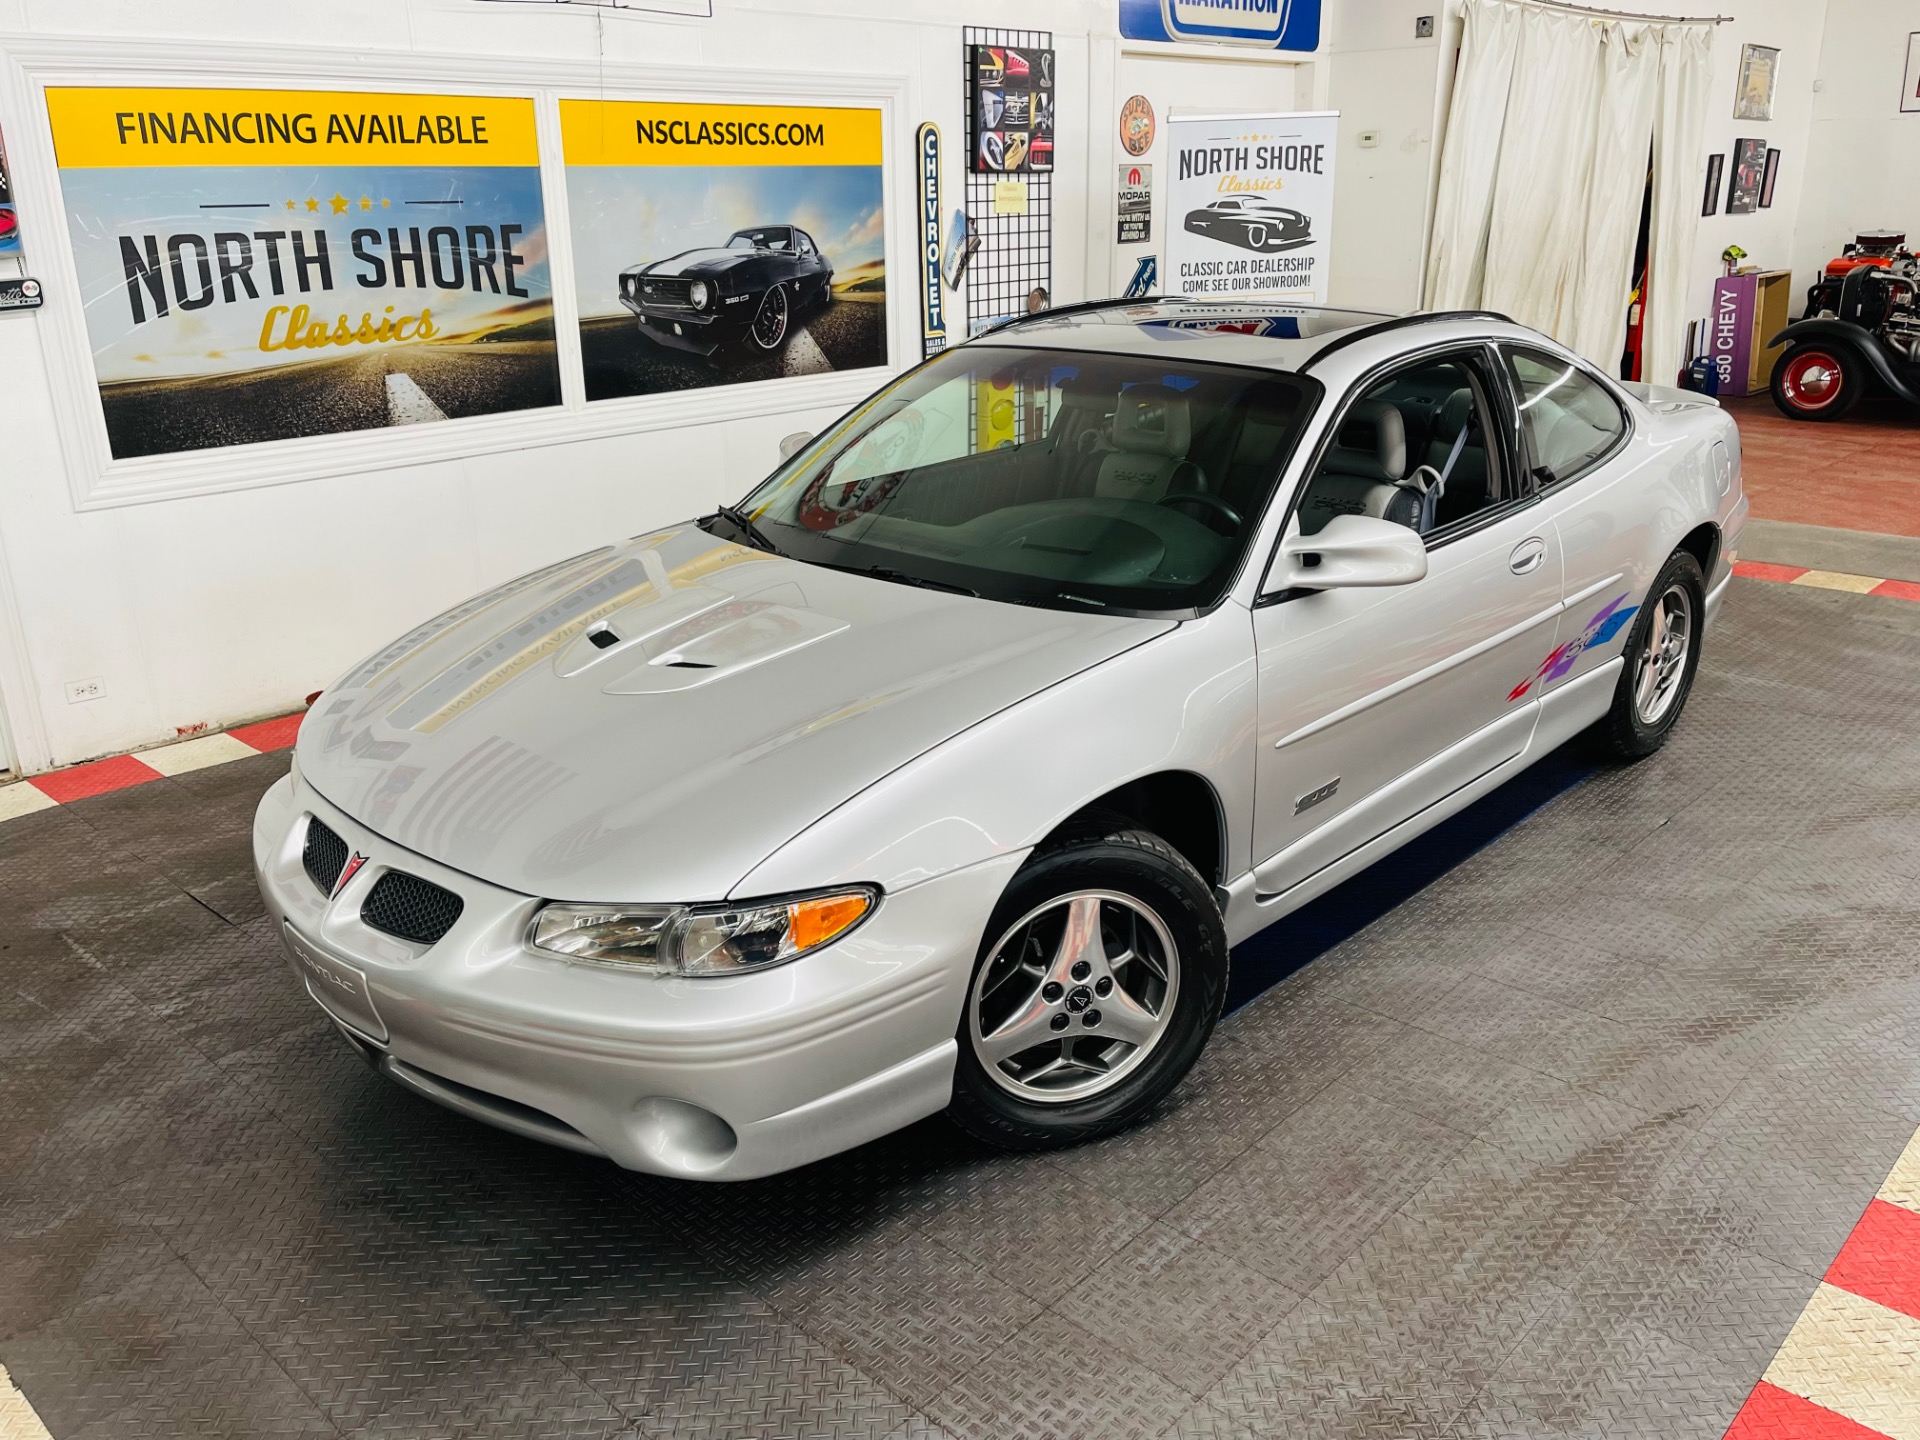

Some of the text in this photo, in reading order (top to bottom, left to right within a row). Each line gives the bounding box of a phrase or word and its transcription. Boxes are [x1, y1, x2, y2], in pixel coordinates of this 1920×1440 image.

[115, 111, 489, 145] FINANCING AVAILABLE
[1123, 99, 1151, 129] SUPER
[636, 119, 824, 147] NSCLASSICS.COM
[1128, 131, 1150, 152] BEE
[1179, 144, 1325, 181] NORTH SHORE
[1118, 191, 1150, 201] MOPAR
[1217, 175, 1284, 193] Classics
[925, 134, 941, 327] CHEVROLET
[119, 224, 529, 325] NORTH SHORE
[1180, 257, 1315, 277] CLASSIC CAR DEALERSHIP
[1182, 274, 1311, 293] COME SEE OUR SHOWROOM!
[258, 303, 440, 353] Classics
[1716, 290, 1738, 384] 350 CHEVY
